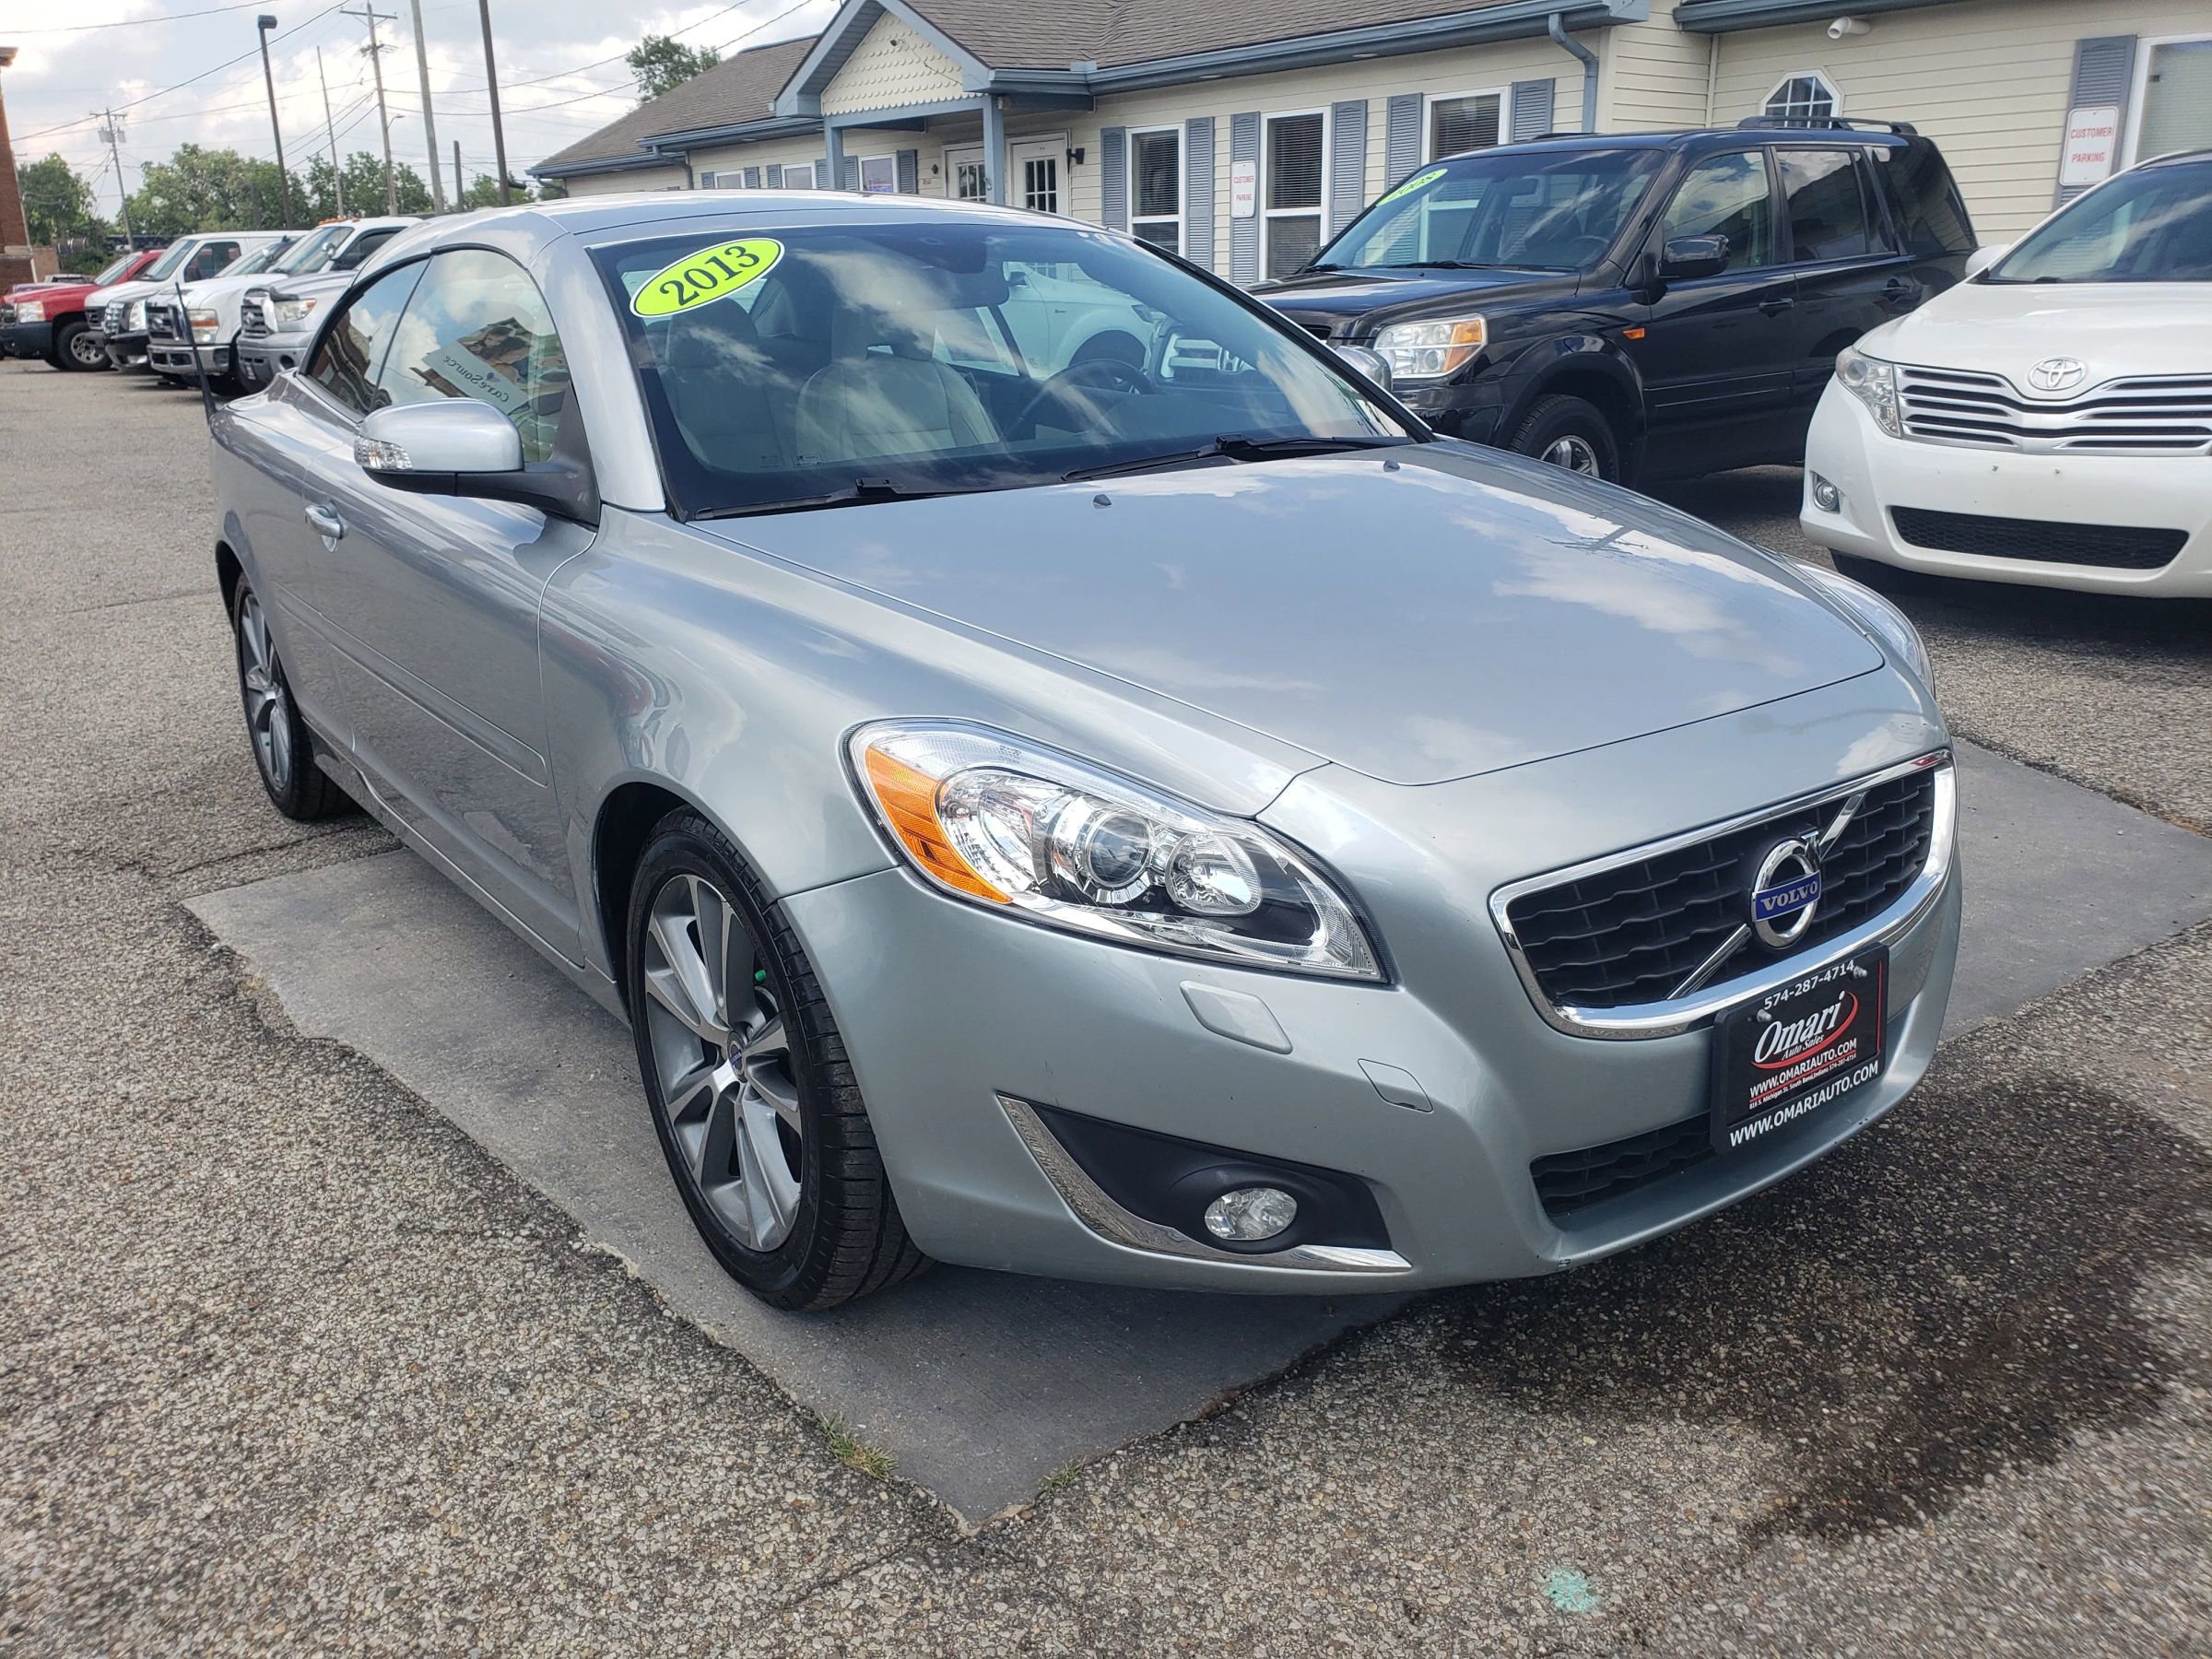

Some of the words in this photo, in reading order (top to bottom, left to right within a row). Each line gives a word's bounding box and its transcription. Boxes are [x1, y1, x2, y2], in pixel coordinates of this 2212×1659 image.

[2070, 126, 2112, 139] CUSTOMER
[2071, 152, 2106, 164] PARKING
[659, 245, 760, 306] 2013
[1759, 880, 1818, 912] VOLVO
[1763, 959, 1855, 1010] 574-287-4714
[1754, 990, 1845, 1063] Omari
[1782, 1043, 1802, 1061] Auto
[1803, 1033, 1825, 1050] Sales
[1749, 1037, 1857, 1099] WWW.OMARIAUTO.COM
[1729, 1060, 1879, 1147] WWW.OMARIAUTO.COM
[1763, 1088, 1783, 1102] Michigan
[1789, 1079, 1802, 1092] South
